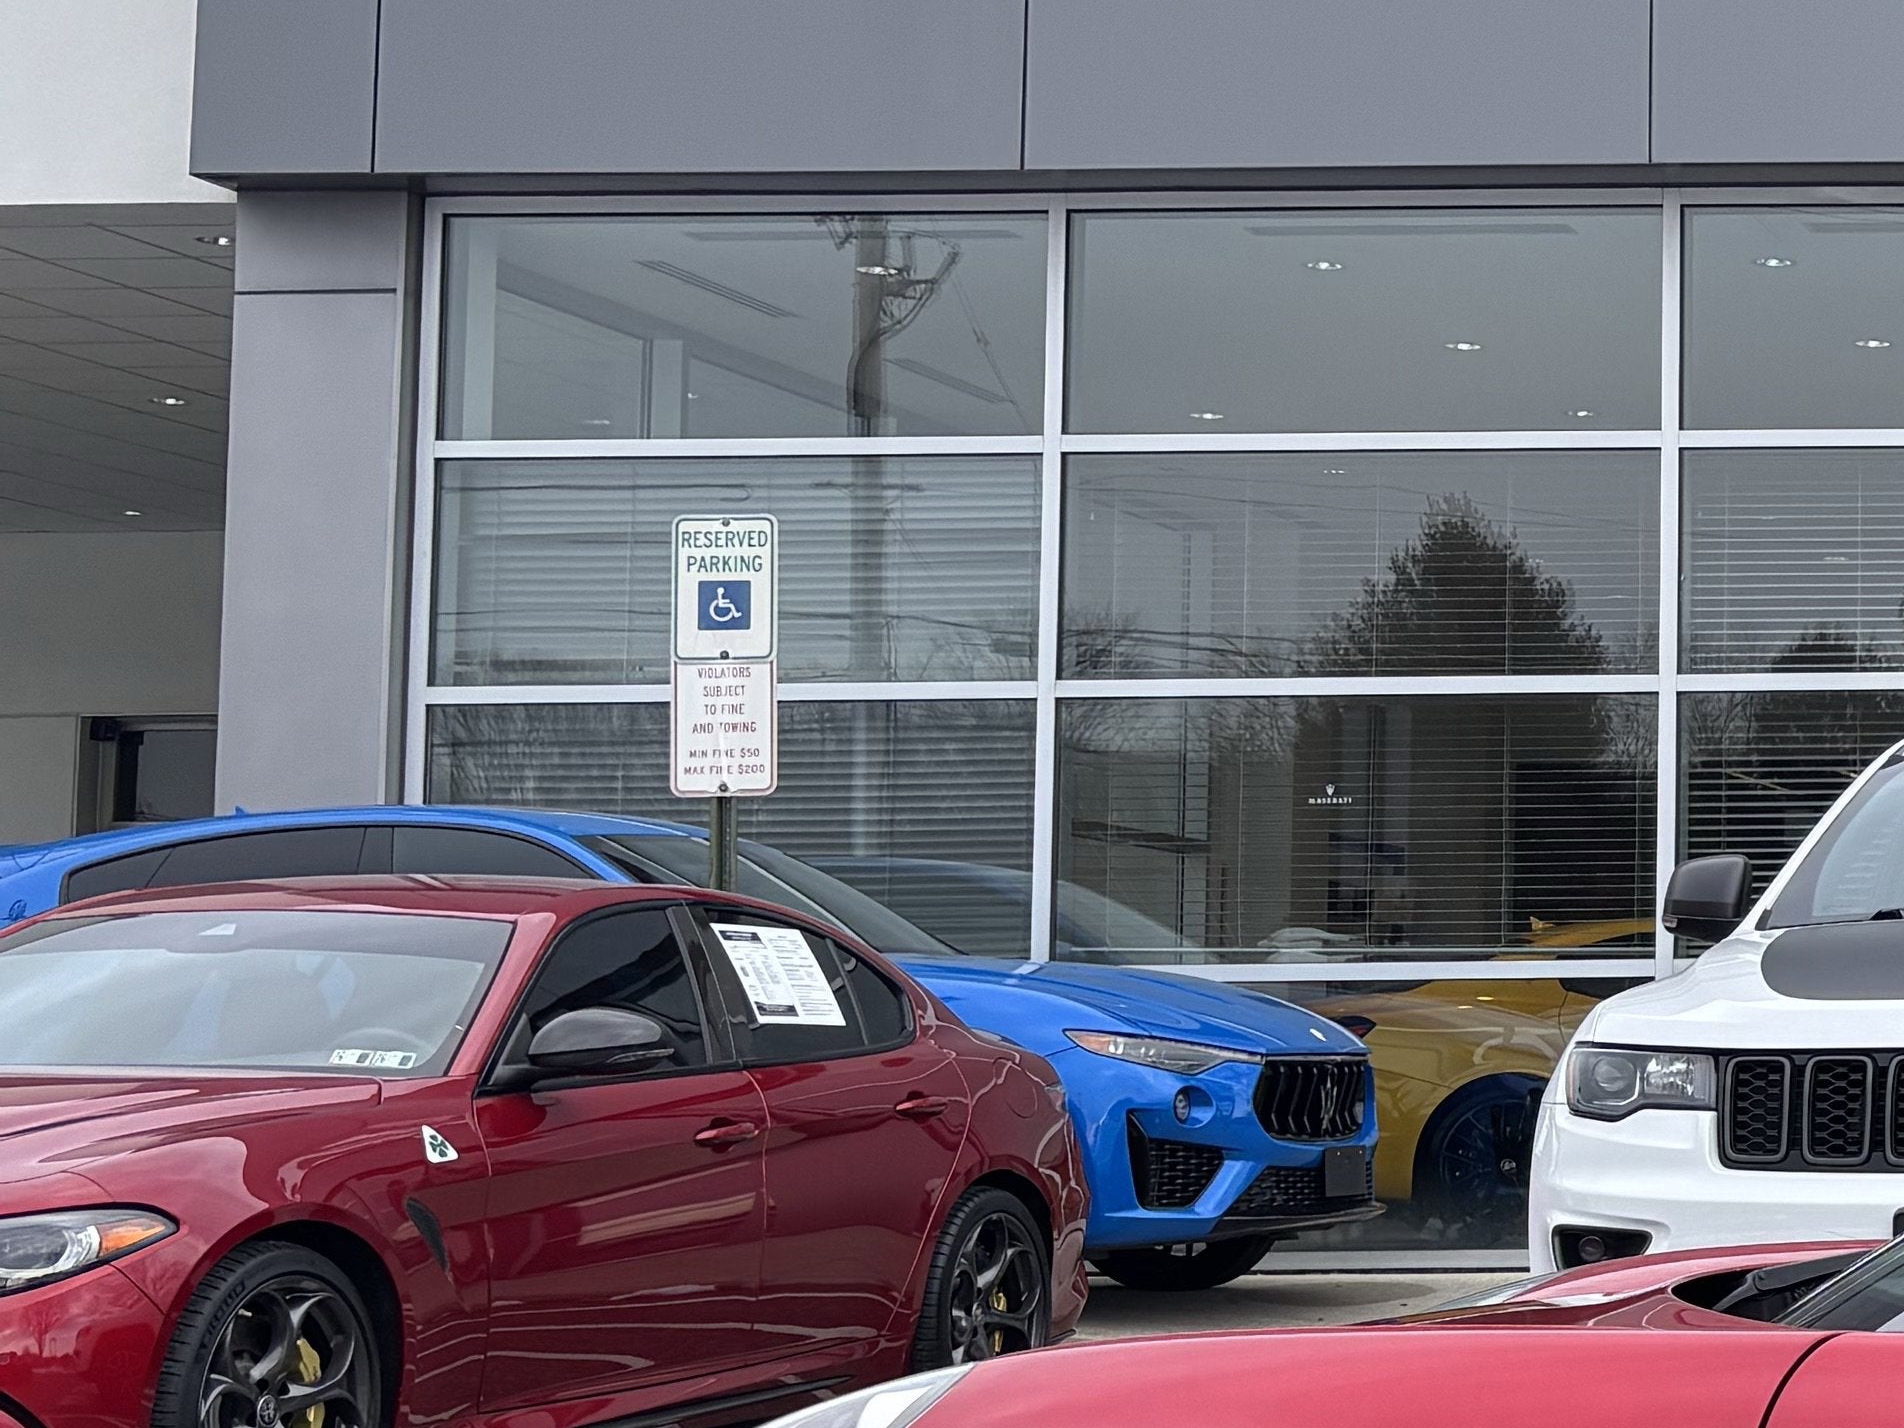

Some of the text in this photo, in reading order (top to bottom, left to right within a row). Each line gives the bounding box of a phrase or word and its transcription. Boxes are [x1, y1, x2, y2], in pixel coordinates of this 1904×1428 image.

[681, 530, 768, 548] RESERVED
[686, 554, 763, 573] PARKING
[697, 667, 751, 679] VIOLATORS
[703, 685, 746, 697] SUBJECT
[704, 703, 745, 715] TO FINE
[692, 723, 714, 734] AND
[740, 747, 760, 758] $50
[738, 763, 765, 774] $200
